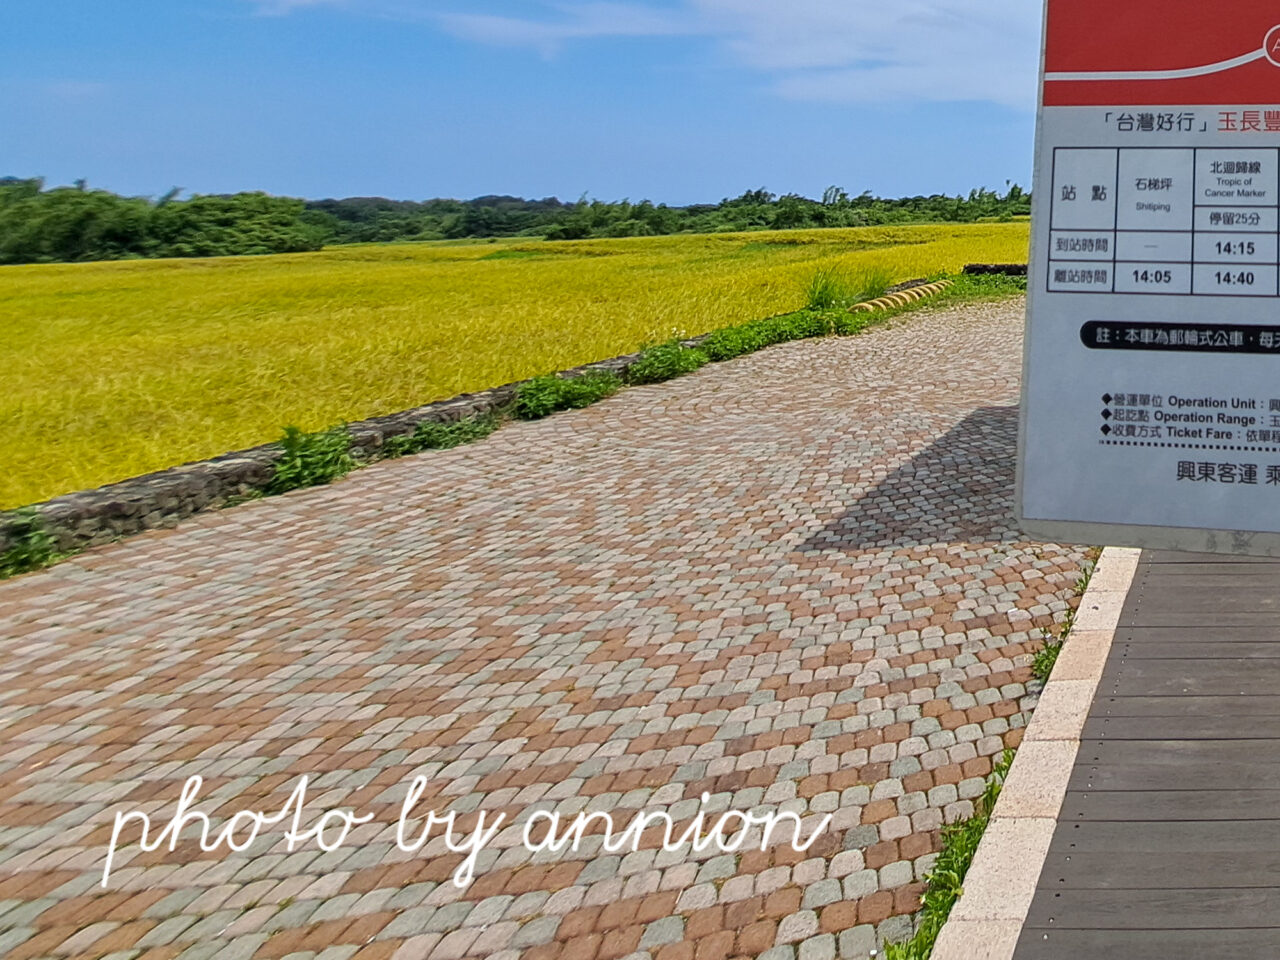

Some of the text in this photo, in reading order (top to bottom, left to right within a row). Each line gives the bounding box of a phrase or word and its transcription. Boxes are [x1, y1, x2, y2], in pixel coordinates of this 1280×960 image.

[1210, 161, 1261, 174] 北迴歸線
[1135, 178, 1172, 190] 石梯坪
[1217, 177, 1252, 187] Tropic of
[1205, 189, 1266, 198] Cancer Marker
[1136, 202, 1170, 212] Shitiping
[1209, 212, 1260, 226] 停留25分
[1055, 238, 1108, 252] 到站時間
[1215, 242, 1255, 255] 14:15
[1054, 270, 1107, 284] 離站時間
[1133, 270, 1172, 283] 14:05
[1215, 272, 1254, 285] 14:40
[1113, 393, 1163, 408] 營運單位
[1168, 395, 1227, 411] Operation
[1153, 410, 1213, 425] Operation
[1112, 424, 1161, 438] 收費方式
[1166, 426, 1202, 439] Ticket
[1177, 461, 1258, 485] 興東客運
